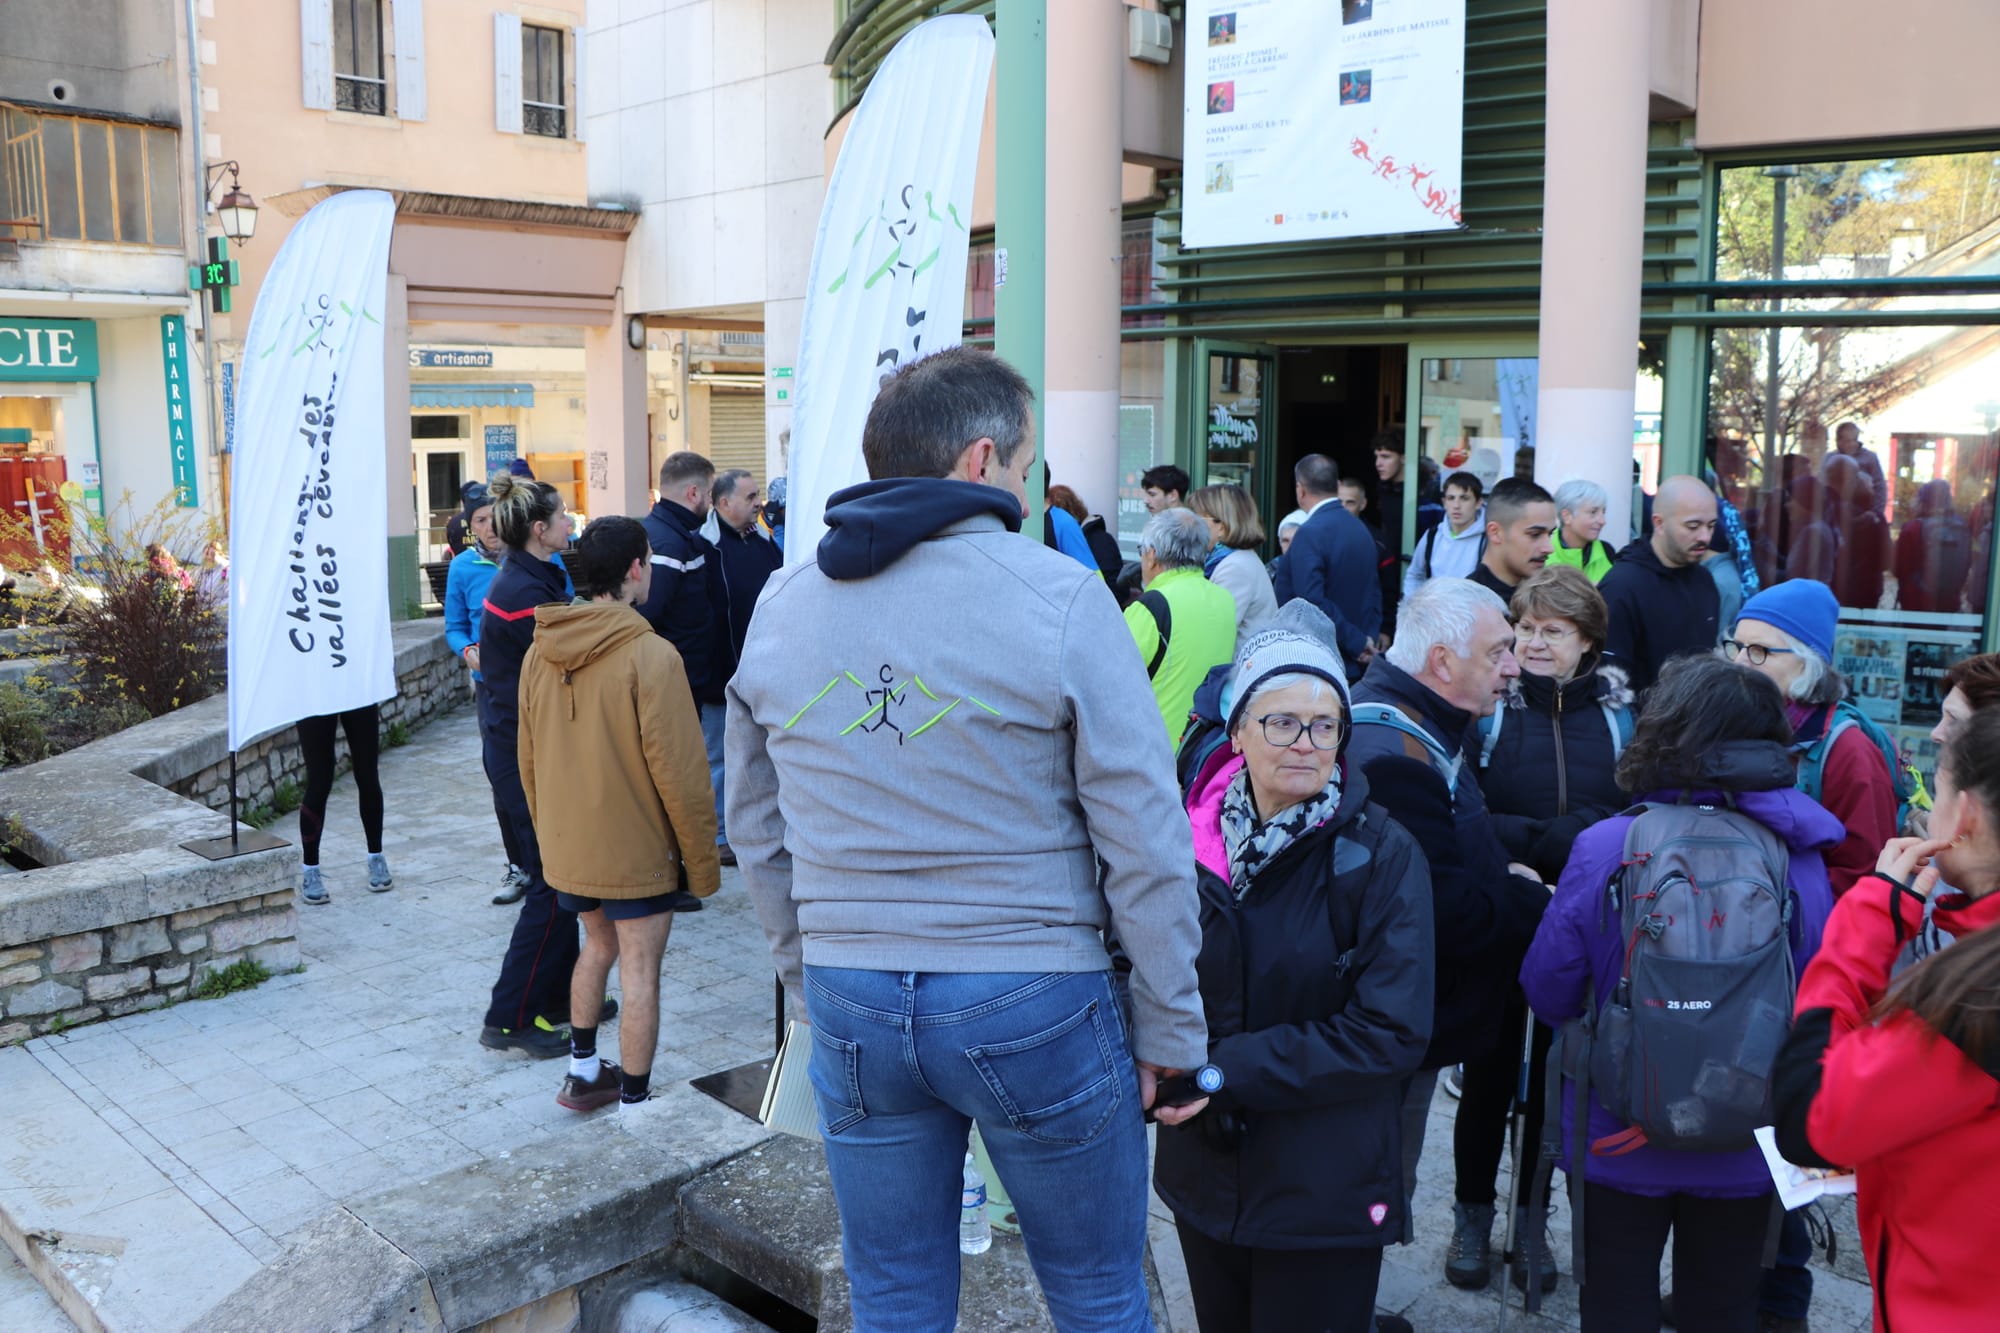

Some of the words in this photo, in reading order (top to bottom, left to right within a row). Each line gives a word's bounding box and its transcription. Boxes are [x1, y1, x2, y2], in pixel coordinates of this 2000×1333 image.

[434, 352, 491, 366] artisanat
[167, 321, 188, 501] PHARMACIE
[312, 543, 347, 668] vallées
[1847, 675, 1900, 700] LUB
[1667, 1000, 1680, 1010] 25
[1682, 1000, 1712, 1010] AERO
